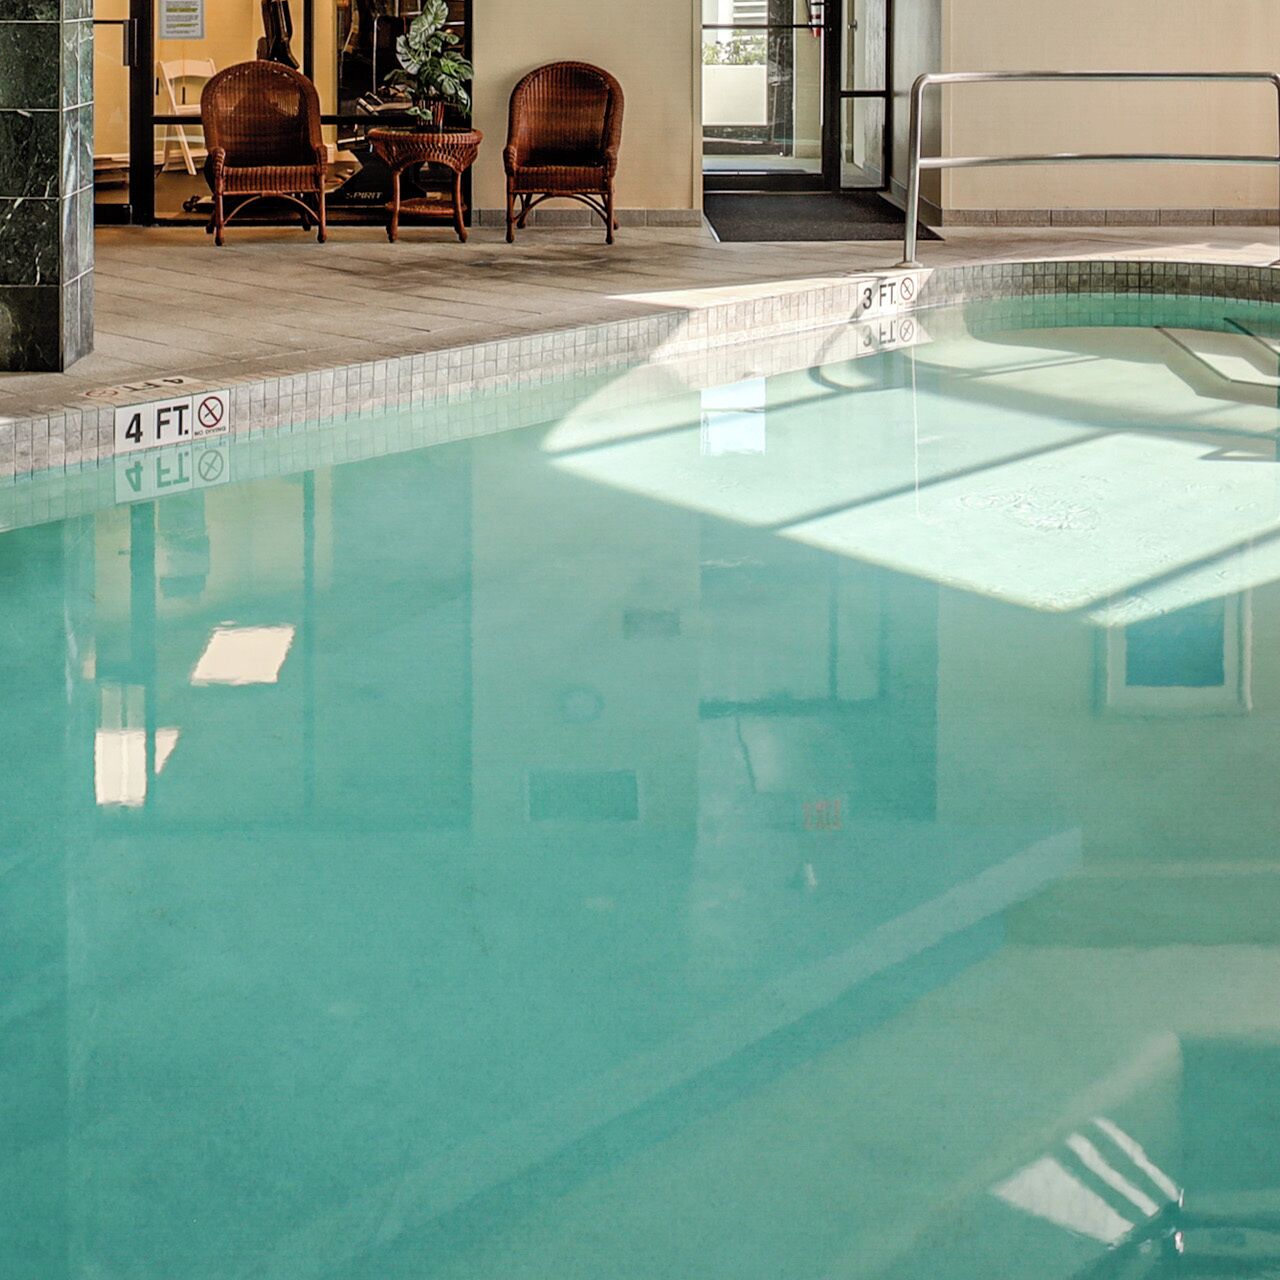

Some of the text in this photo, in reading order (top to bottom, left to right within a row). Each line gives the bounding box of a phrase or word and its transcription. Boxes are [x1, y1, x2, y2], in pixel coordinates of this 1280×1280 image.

[863, 287, 873, 310] 3
[125, 404, 189, 443] 4 FT.
